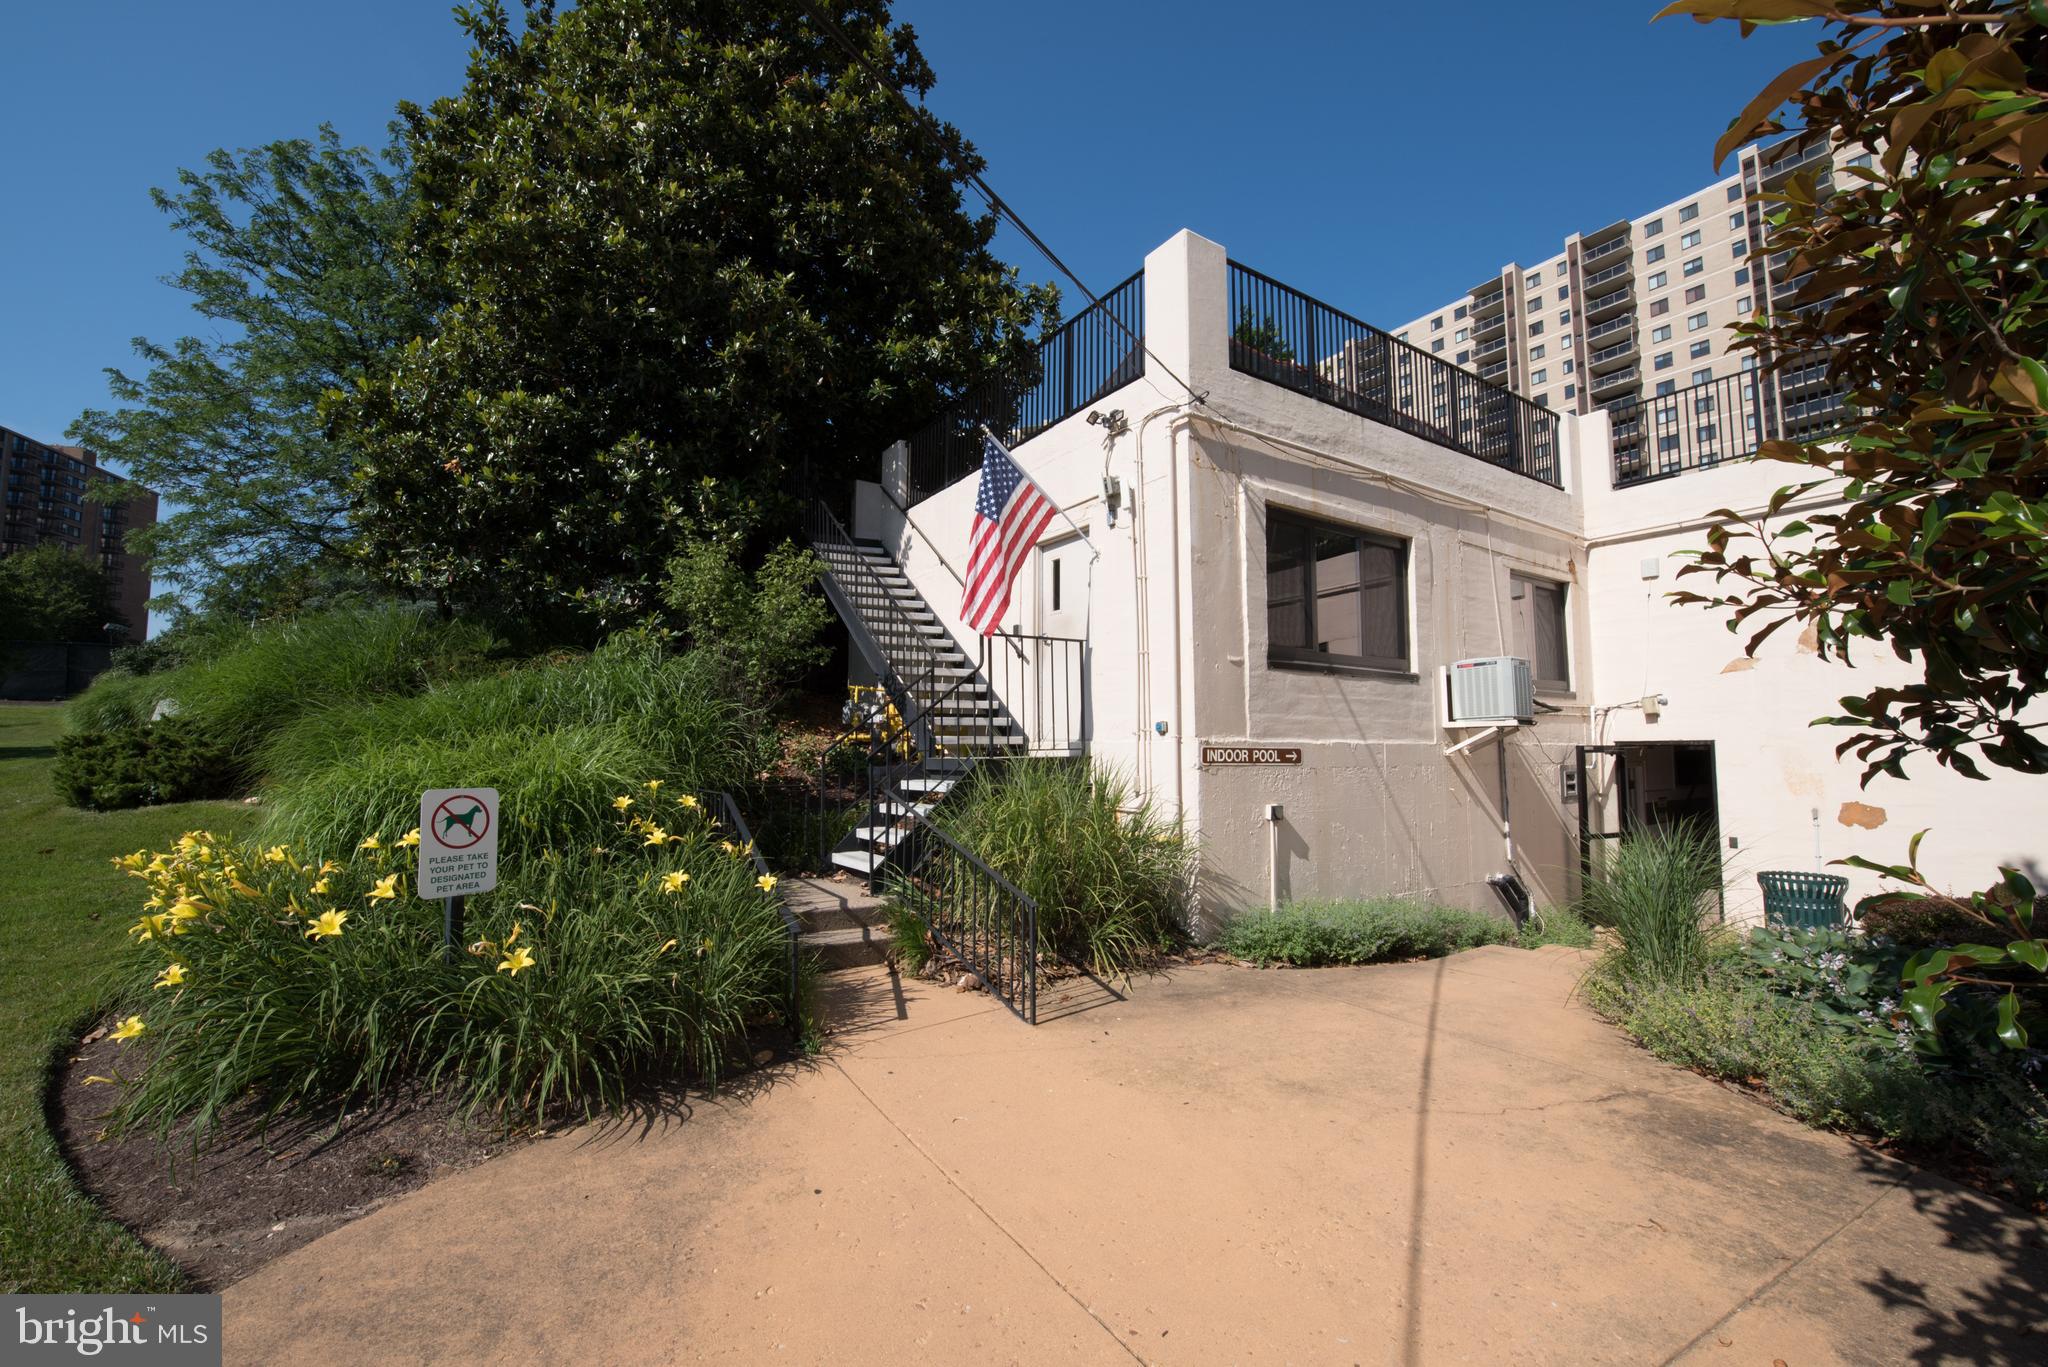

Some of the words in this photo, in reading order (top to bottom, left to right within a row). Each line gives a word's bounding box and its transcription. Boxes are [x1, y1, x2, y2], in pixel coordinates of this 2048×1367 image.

[1206, 749, 1249, 762] INDOOR
[1252, 750, 1281, 762] POOL
[429, 854, 464, 864] PLEASE
[467, 852, 489, 860] TAKE
[430, 865, 455, 874] YOUR
[430, 871, 487, 884] DESIGNATED
[436, 885, 453, 893] PET
[455, 882, 480, 891] AREA
